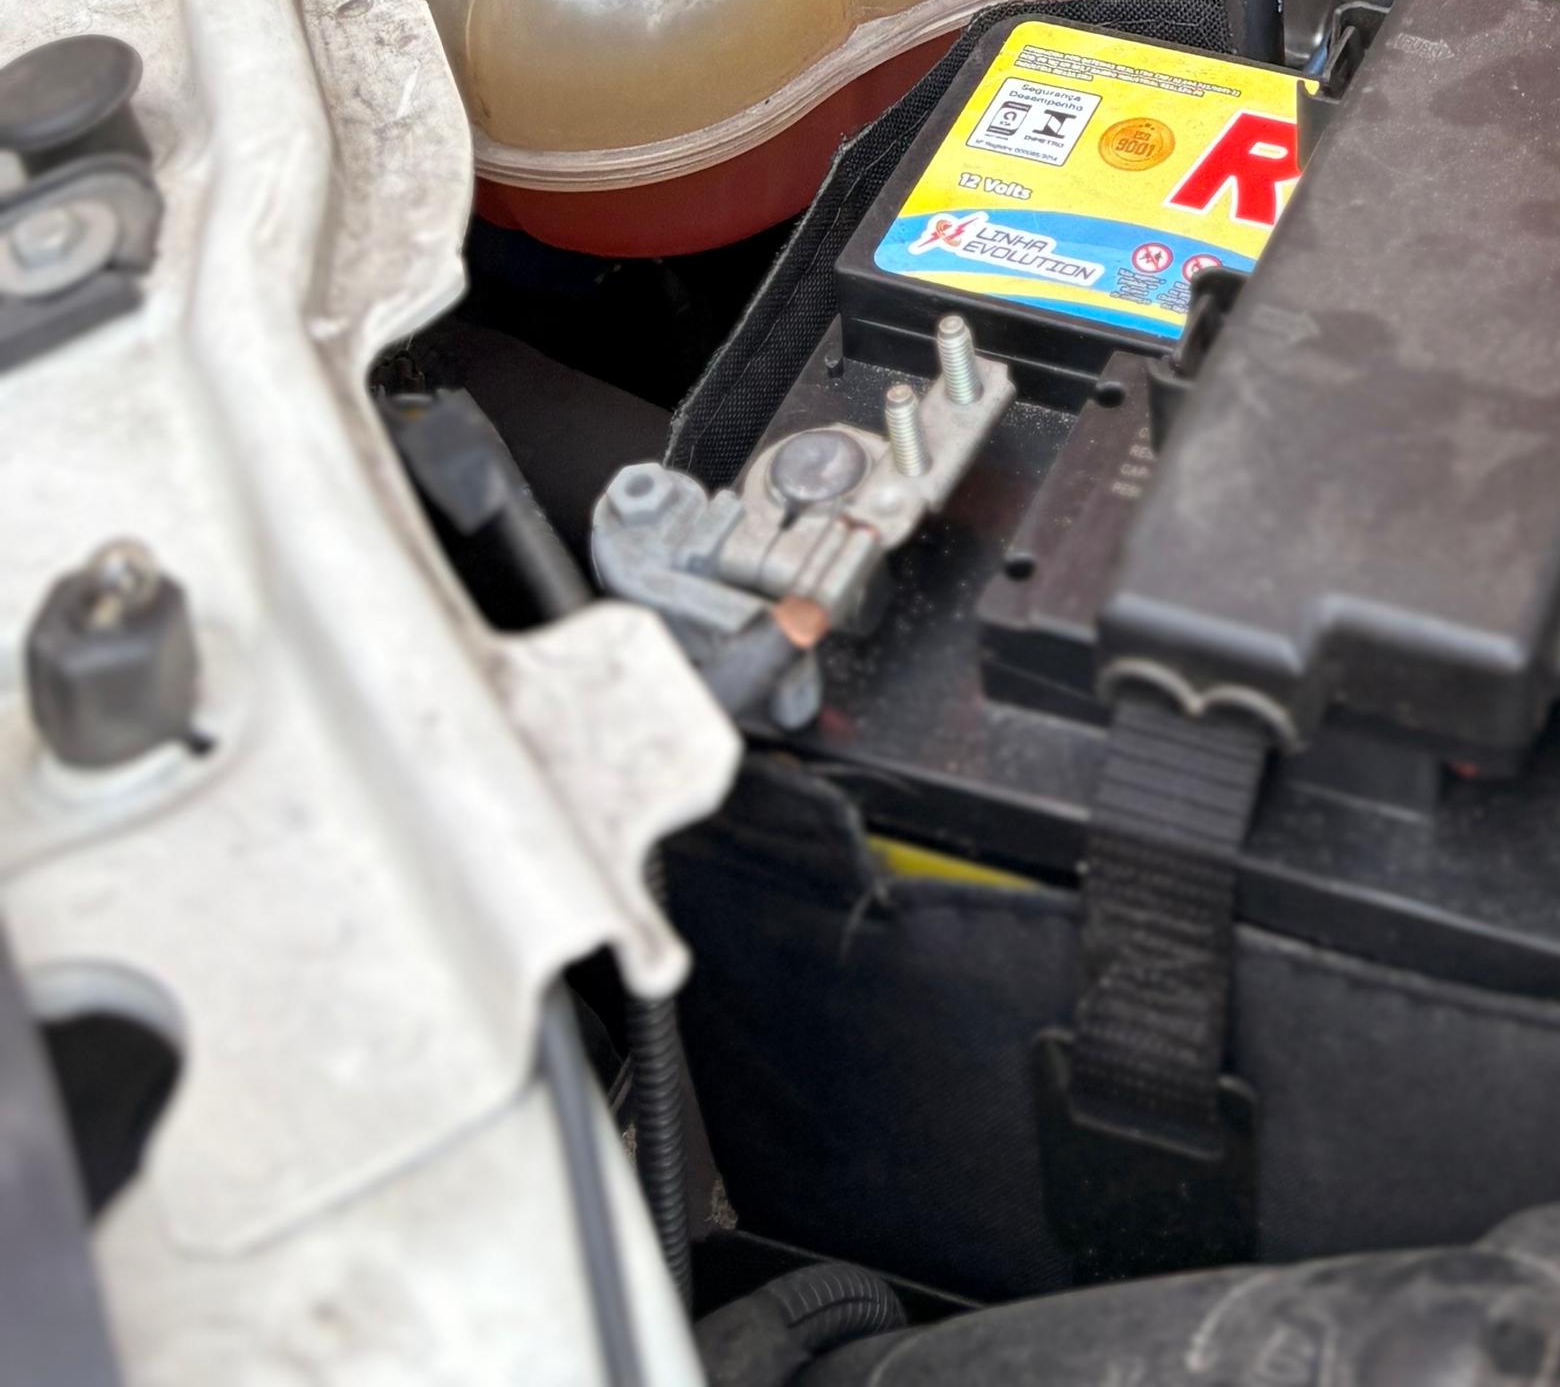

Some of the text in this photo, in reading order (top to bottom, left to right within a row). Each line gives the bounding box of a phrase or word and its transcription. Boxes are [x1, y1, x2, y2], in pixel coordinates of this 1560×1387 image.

[1009, 90, 1084, 112] Desempenho
[1021, 84, 1082, 102] Segurança
[1116, 138, 1156, 157] 9001
[959, 172, 1032, 200] 12 Volts
[976, 227, 1048, 252] LINHA
[963, 240, 1096, 280] EVOLUTION
